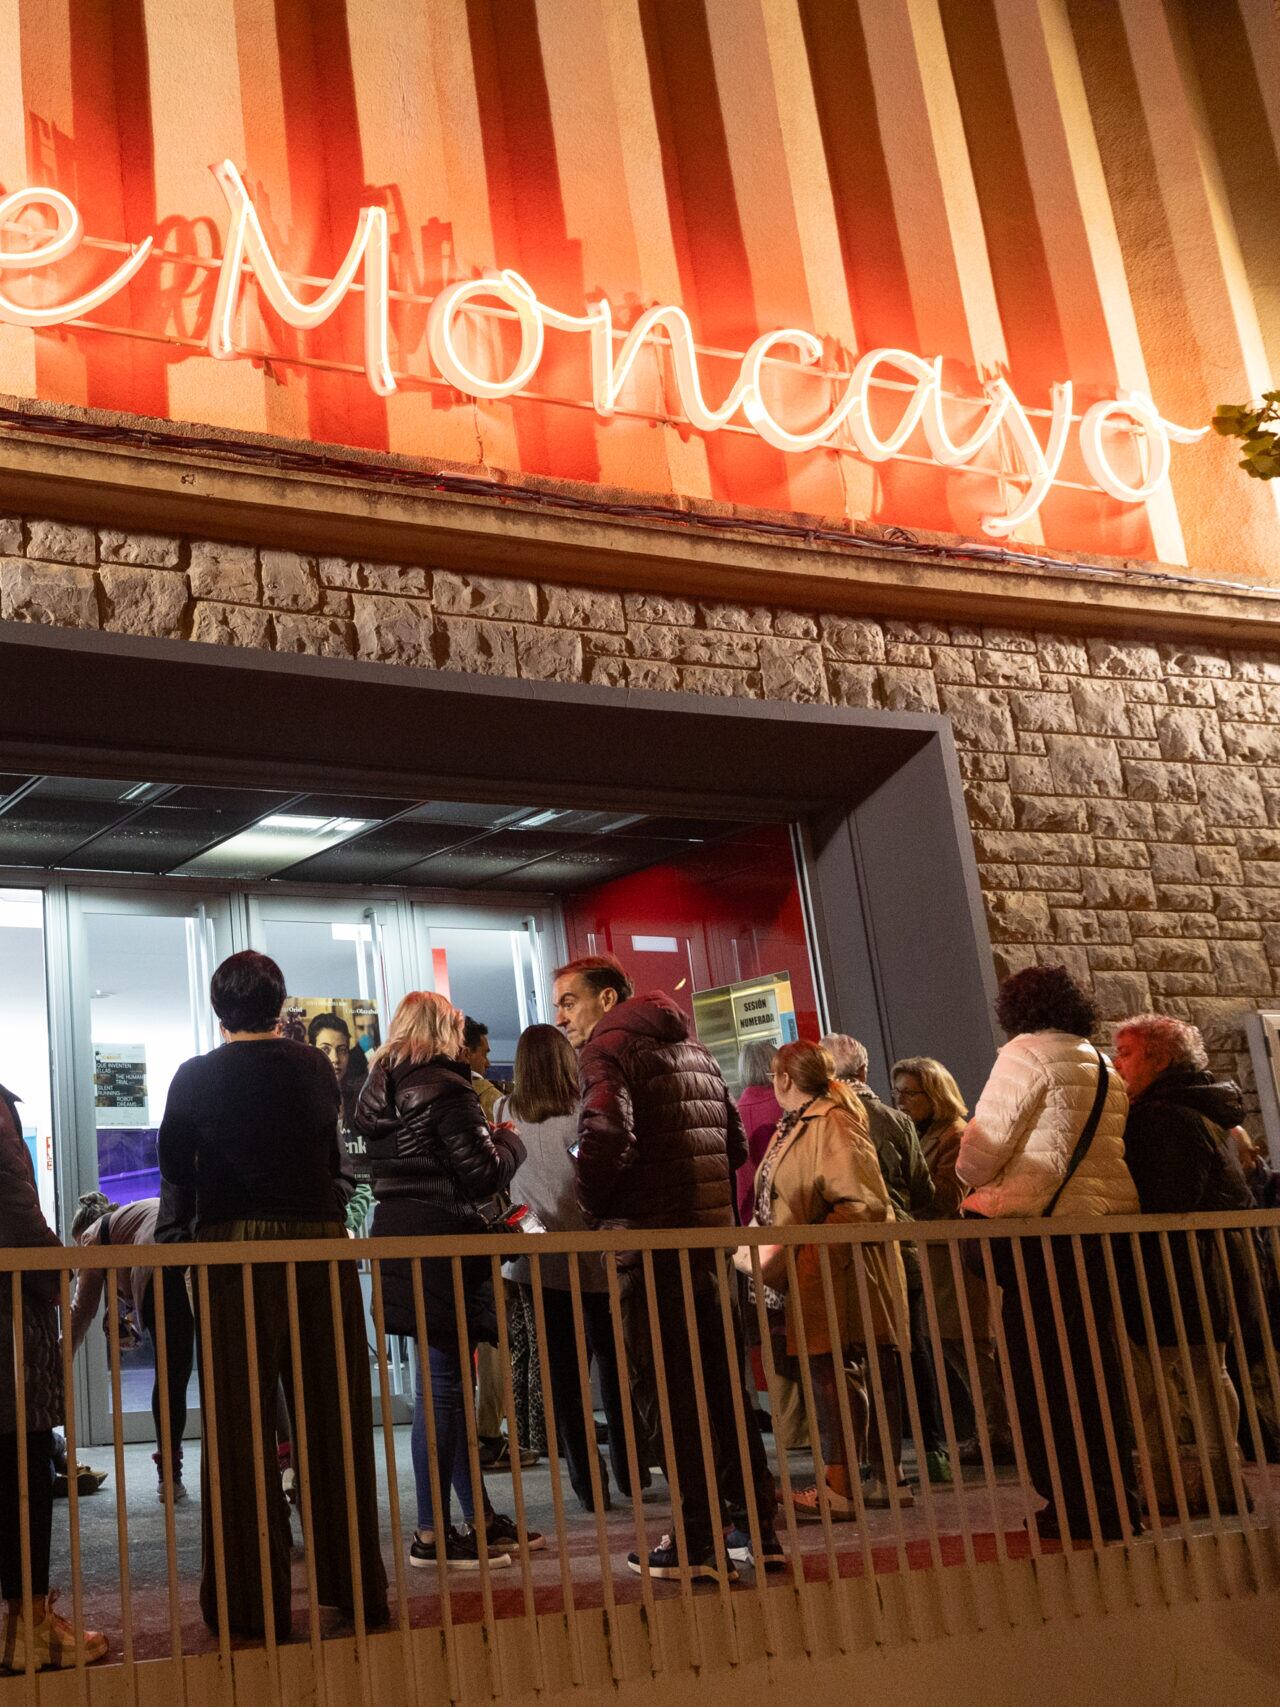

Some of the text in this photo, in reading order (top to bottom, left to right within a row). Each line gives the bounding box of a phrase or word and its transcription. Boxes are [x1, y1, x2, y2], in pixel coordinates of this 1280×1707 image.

[208, 157, 1210, 537] Moncayo
[743, 997, 767, 1012] SESIÓN
[739, 1013, 775, 1028] NUMERADA
